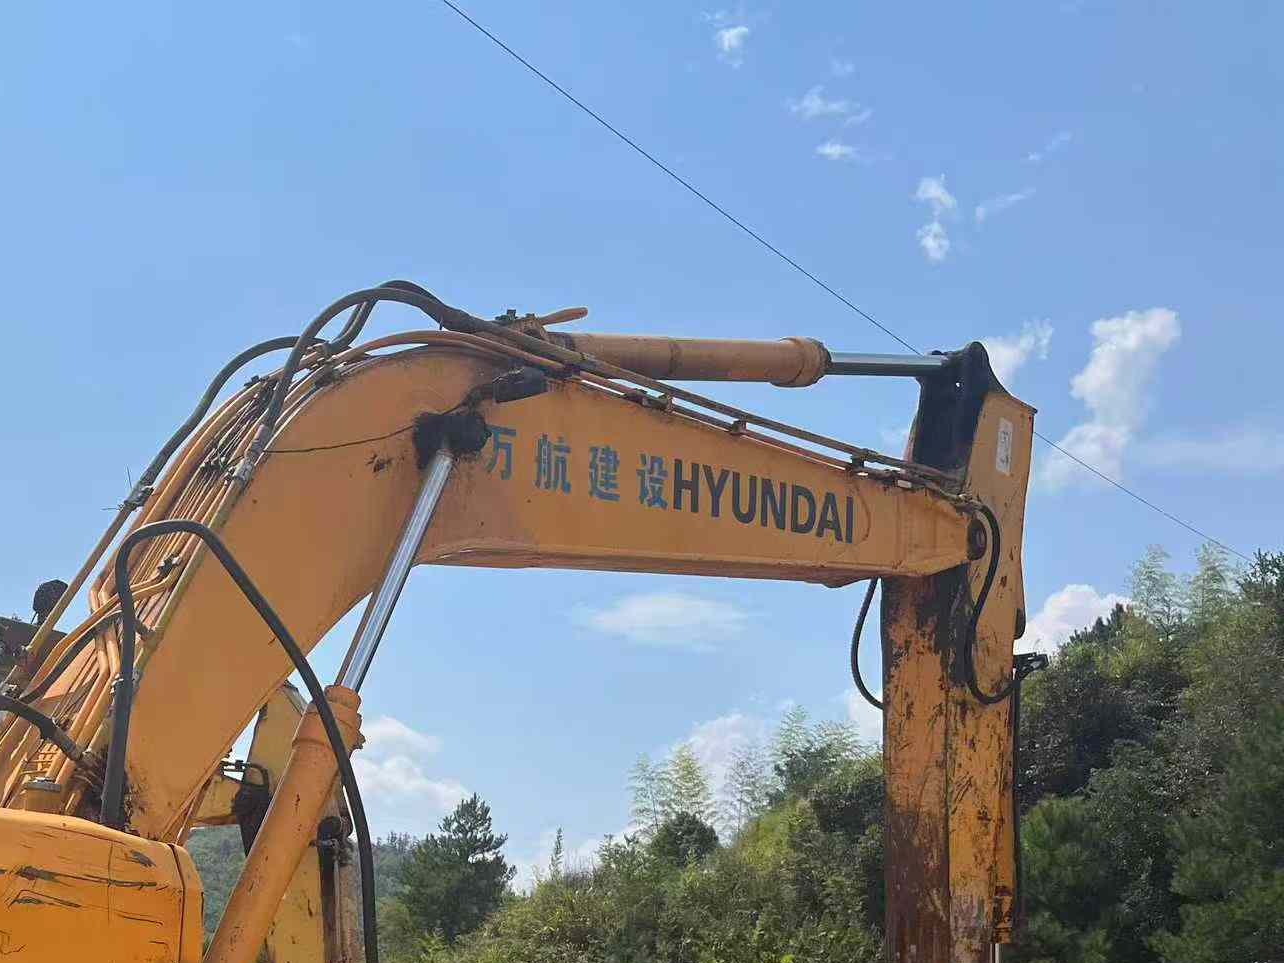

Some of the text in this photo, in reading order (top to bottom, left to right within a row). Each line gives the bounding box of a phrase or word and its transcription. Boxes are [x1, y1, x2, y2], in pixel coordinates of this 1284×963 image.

[485, 423, 854, 544] 万航建设 HYUNDAI
